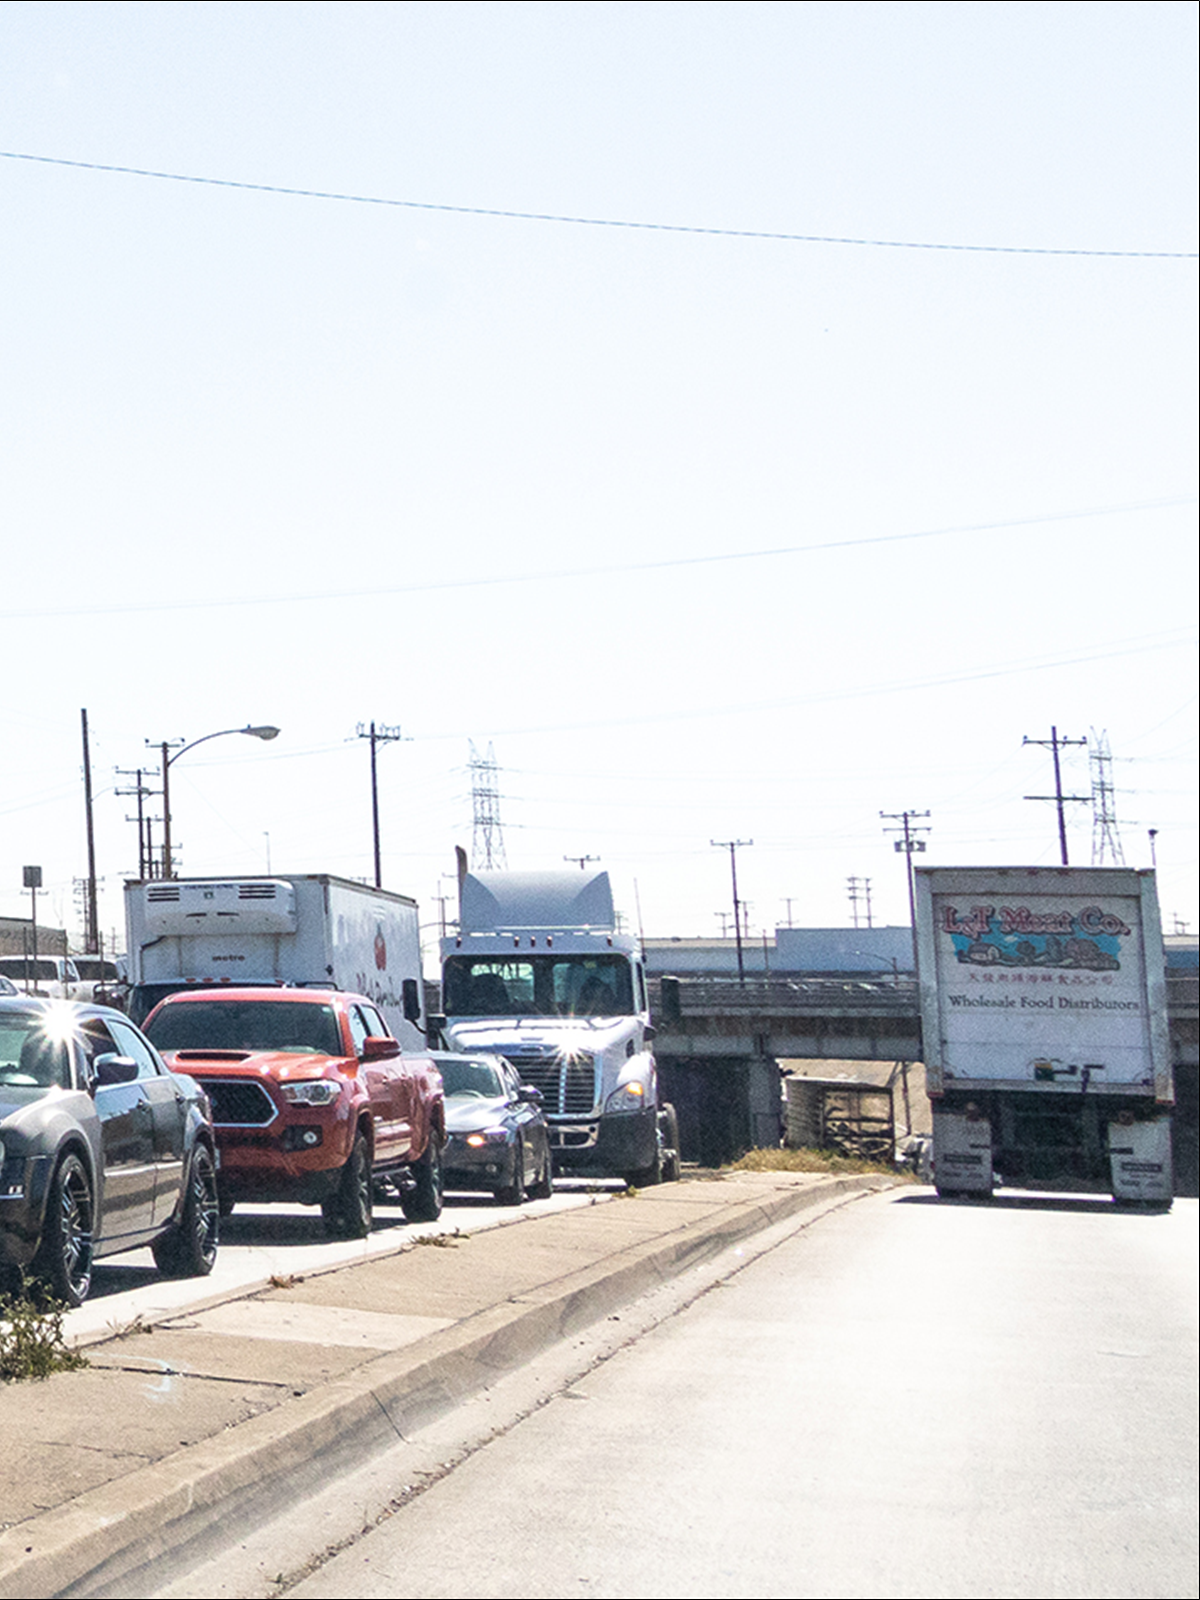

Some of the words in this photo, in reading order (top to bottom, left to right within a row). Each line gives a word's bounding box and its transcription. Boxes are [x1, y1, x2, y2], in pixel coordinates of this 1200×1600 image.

[999, 905, 1074, 935] Meat
[948, 995, 1016, 1009] Wholesale
[1020, 996, 1054, 1009] Food
[1058, 996, 1139, 1011] Distributors
